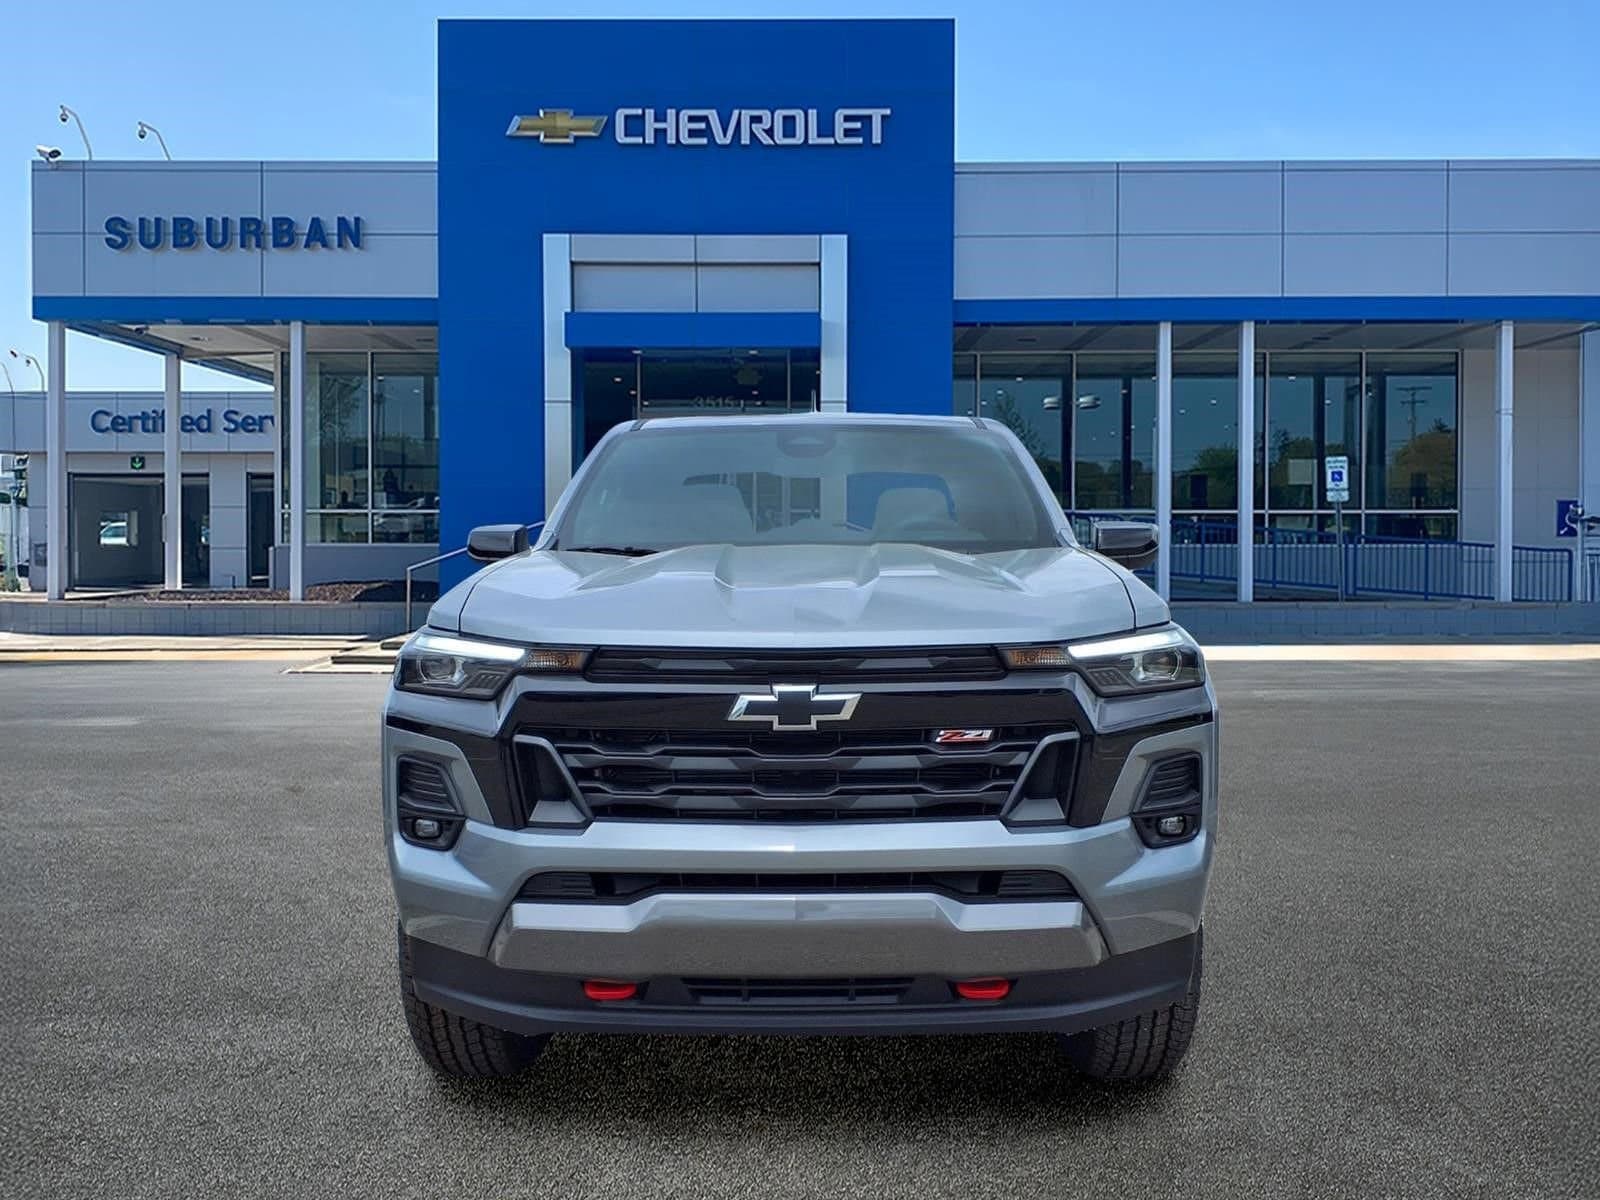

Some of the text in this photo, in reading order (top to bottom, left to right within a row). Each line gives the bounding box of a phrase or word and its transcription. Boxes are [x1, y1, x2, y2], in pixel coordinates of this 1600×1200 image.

[614, 107, 891, 146] CHEVROLET
[104, 216, 362, 250] SUBURBAN
[90, 408, 213, 434] Certifed
